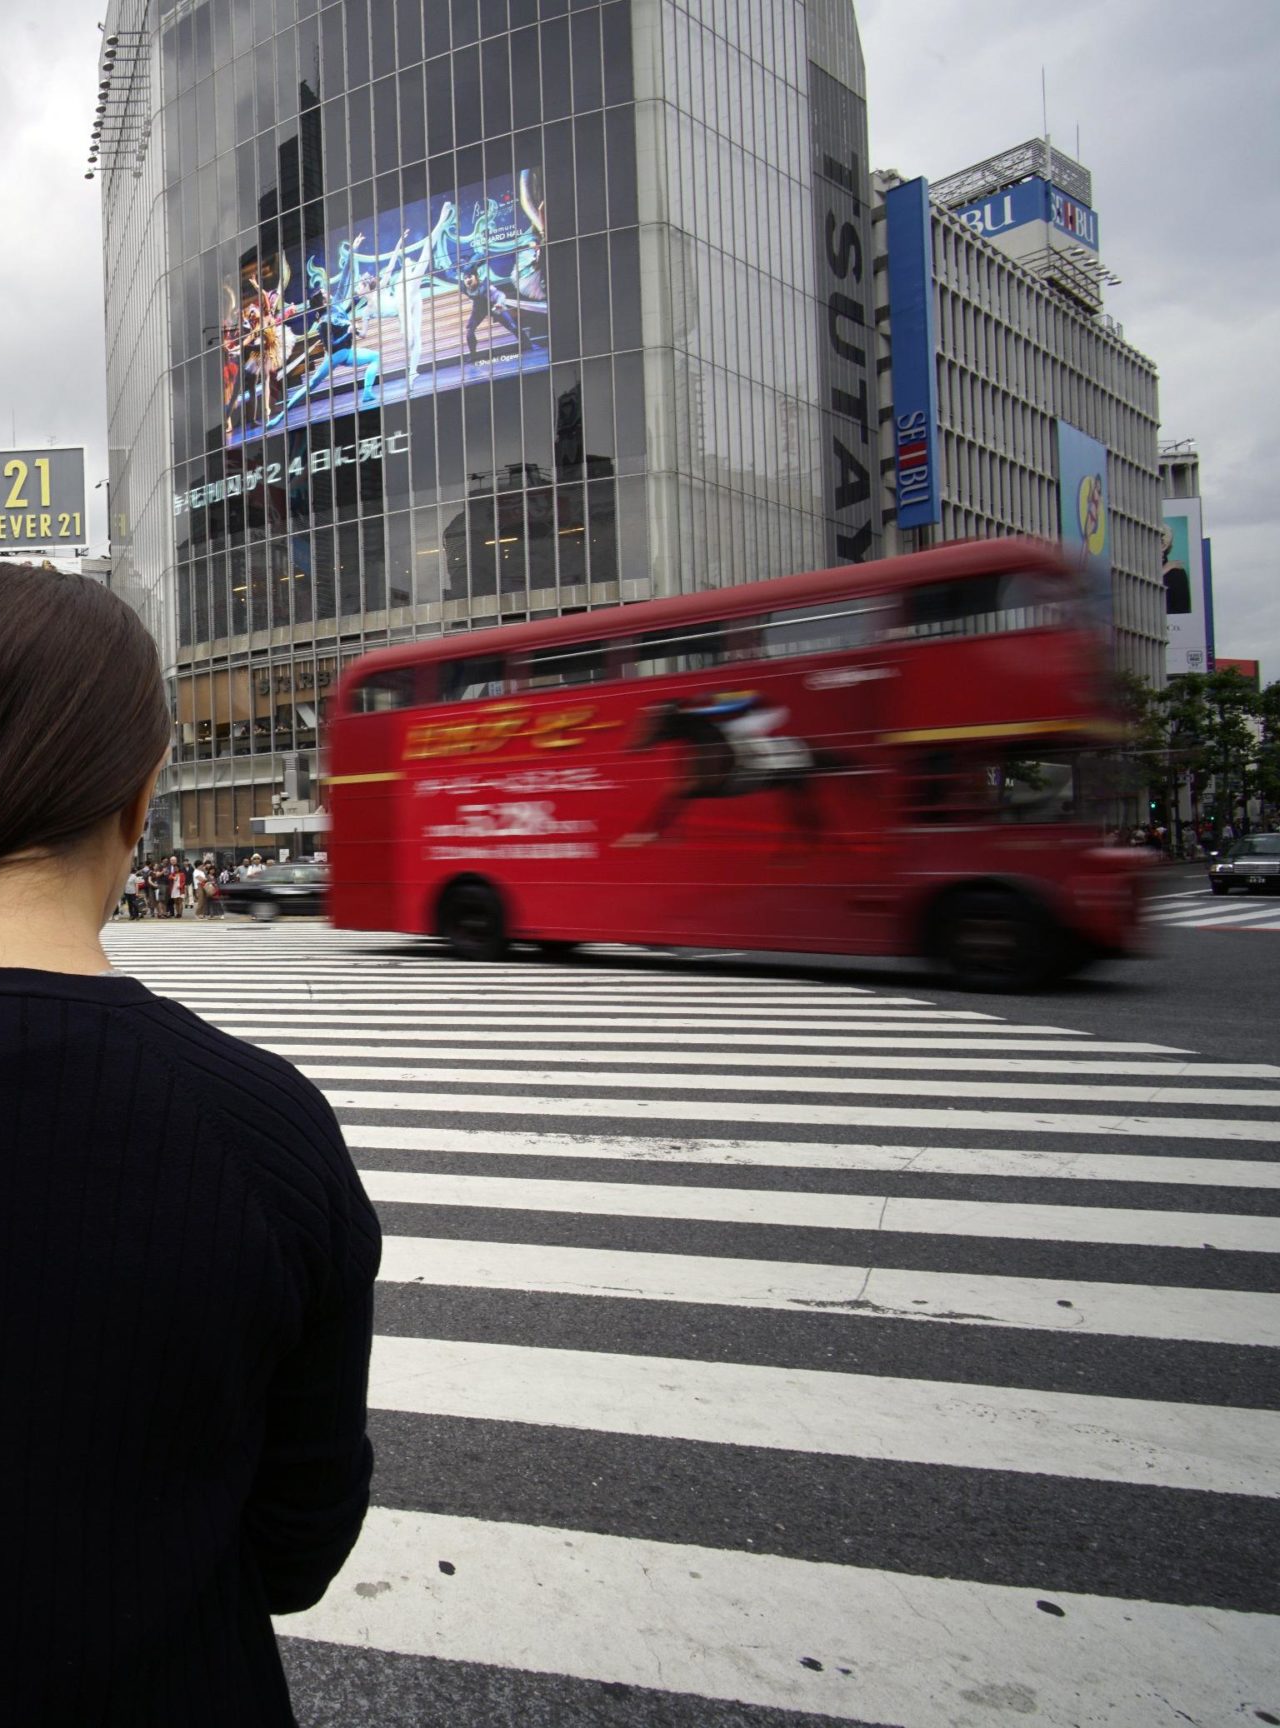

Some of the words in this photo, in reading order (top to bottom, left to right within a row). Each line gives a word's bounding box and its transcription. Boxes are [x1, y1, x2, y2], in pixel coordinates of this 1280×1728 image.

[1051, 192, 1095, 244] SEIBU
[897, 410, 929, 507] SEIBU
[58, 512, 81, 537] 21
